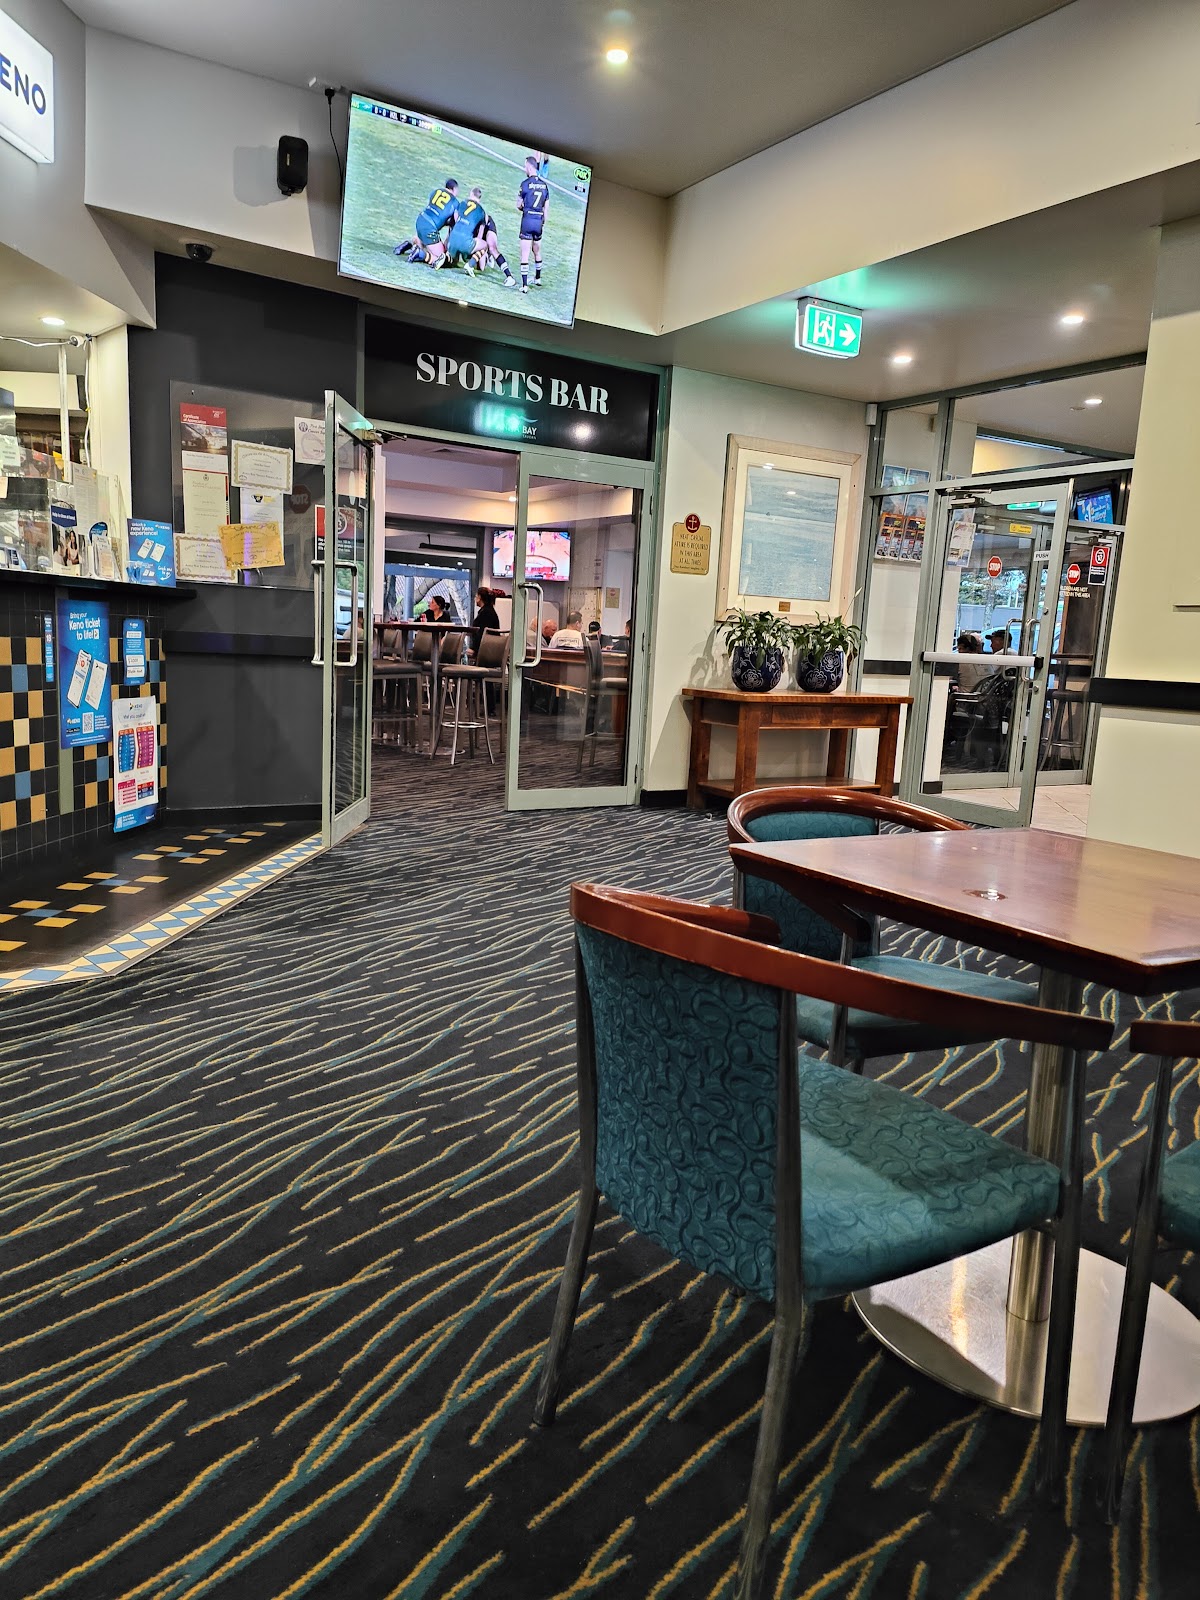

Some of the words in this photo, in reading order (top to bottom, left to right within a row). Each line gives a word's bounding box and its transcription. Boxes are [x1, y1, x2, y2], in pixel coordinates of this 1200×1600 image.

[0, 52, 46, 115] ENO
[575, 169, 588, 180] FOX
[431, 189, 451, 210] 12
[533, 191, 542, 208] 7
[463, 201, 477, 216] 7
[416, 352, 544, 403] SPORTS
[549, 378, 610, 415] BAR
[522, 425, 537, 436] BAY
[690, 543, 708, 551] REQUIRED
[989, 562, 1001, 571] STOP
[1069, 570, 1080, 579] STOP
[69, 620, 84, 631] Keno
[85, 617, 100, 628] ticket
[76, 631, 83, 640] to
